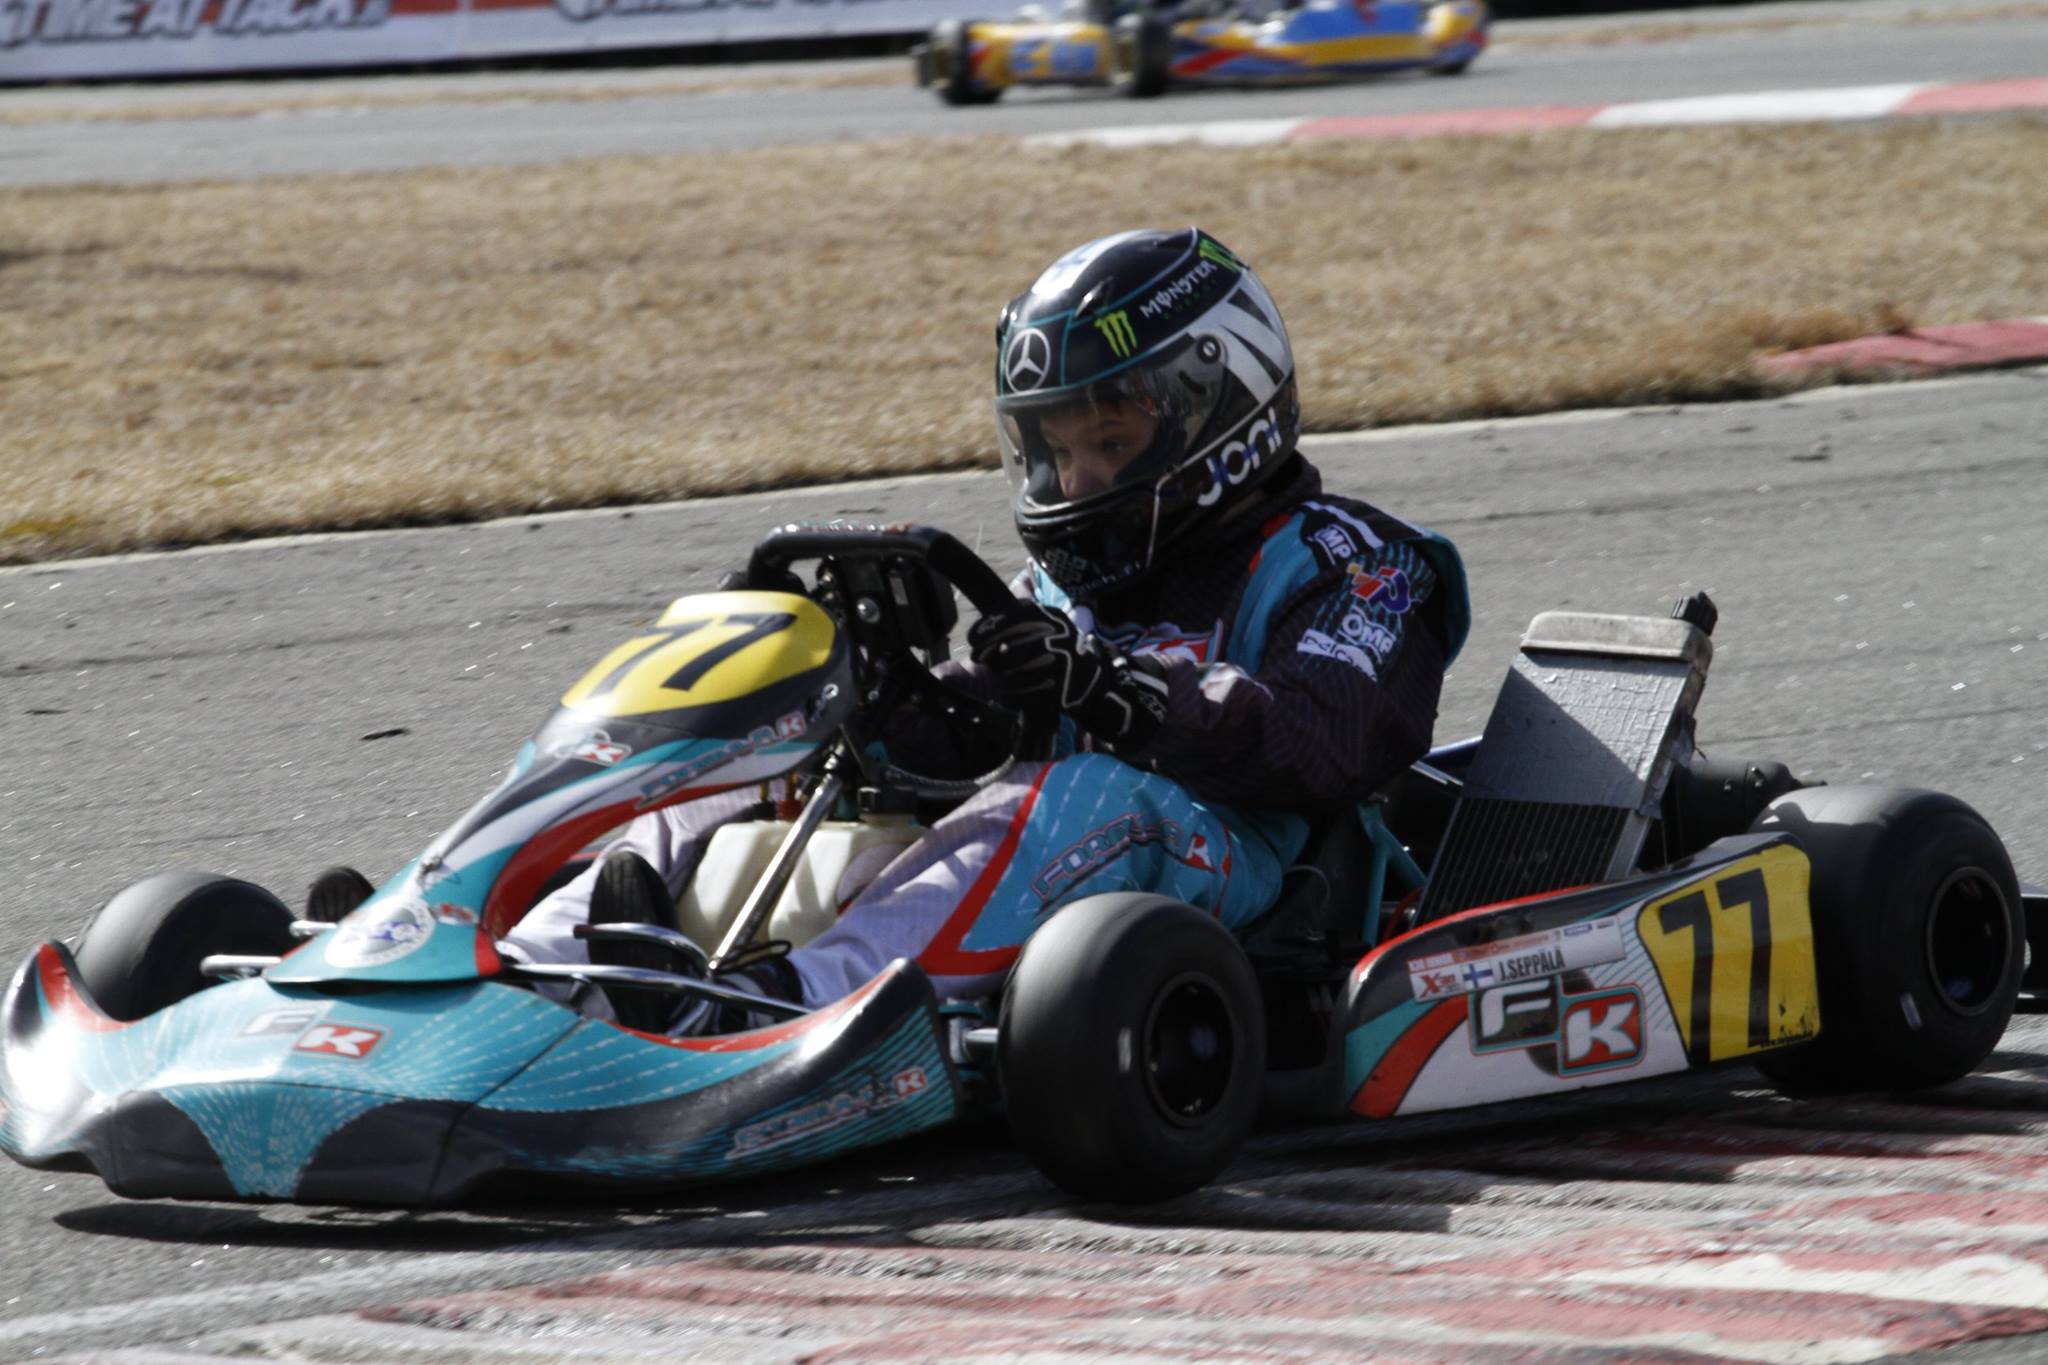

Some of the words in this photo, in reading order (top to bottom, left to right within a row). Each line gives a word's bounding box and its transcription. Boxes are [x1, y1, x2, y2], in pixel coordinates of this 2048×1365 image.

[1138, 259, 1219, 319] MONSTER
[585, 612, 798, 700] 77
[1341, 612, 1396, 655] OMP
[1659, 868, 1772, 1063] 77
